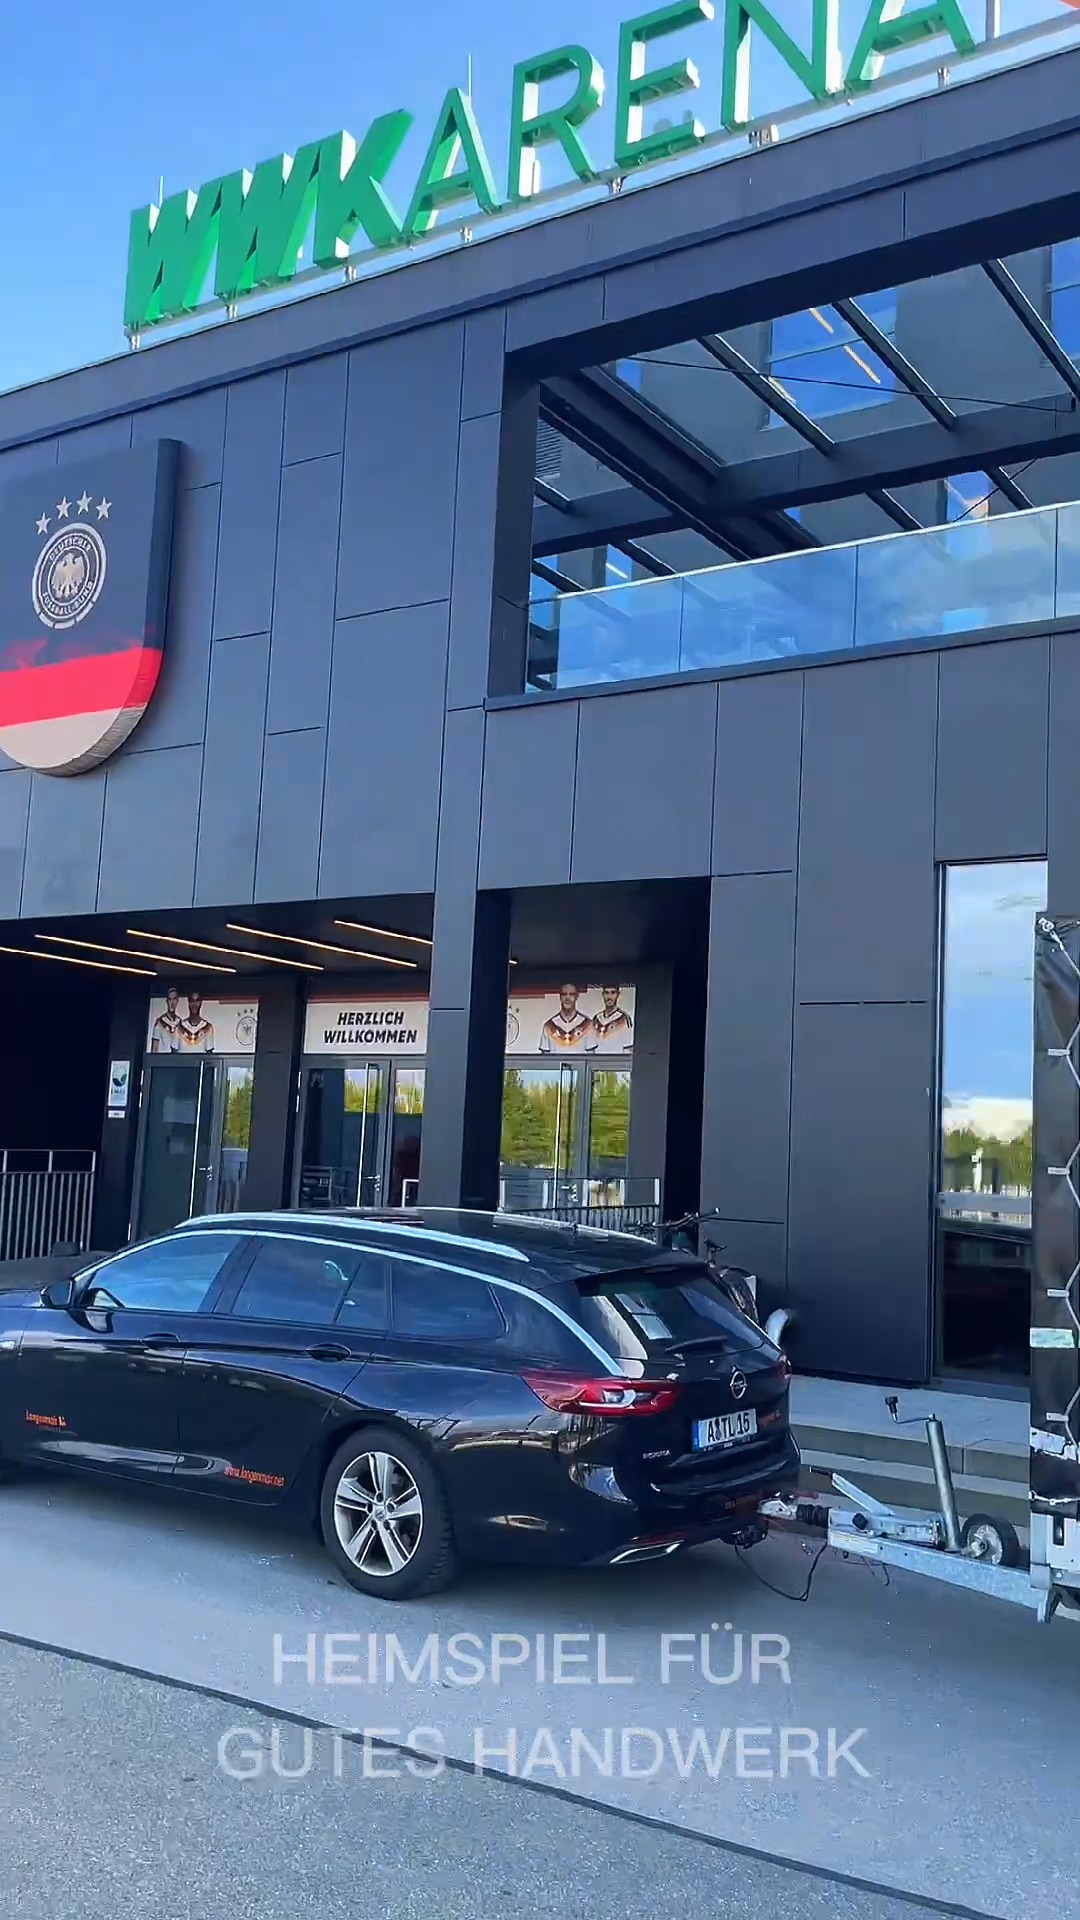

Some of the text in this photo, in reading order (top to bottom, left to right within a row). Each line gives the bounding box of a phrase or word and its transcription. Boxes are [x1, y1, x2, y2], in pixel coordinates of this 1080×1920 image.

[124, 0, 977, 328] WWK ARENA
[337, 1011, 404, 1025] HERZLICH
[324, 1030, 417, 1043] WILLKOMMEN
